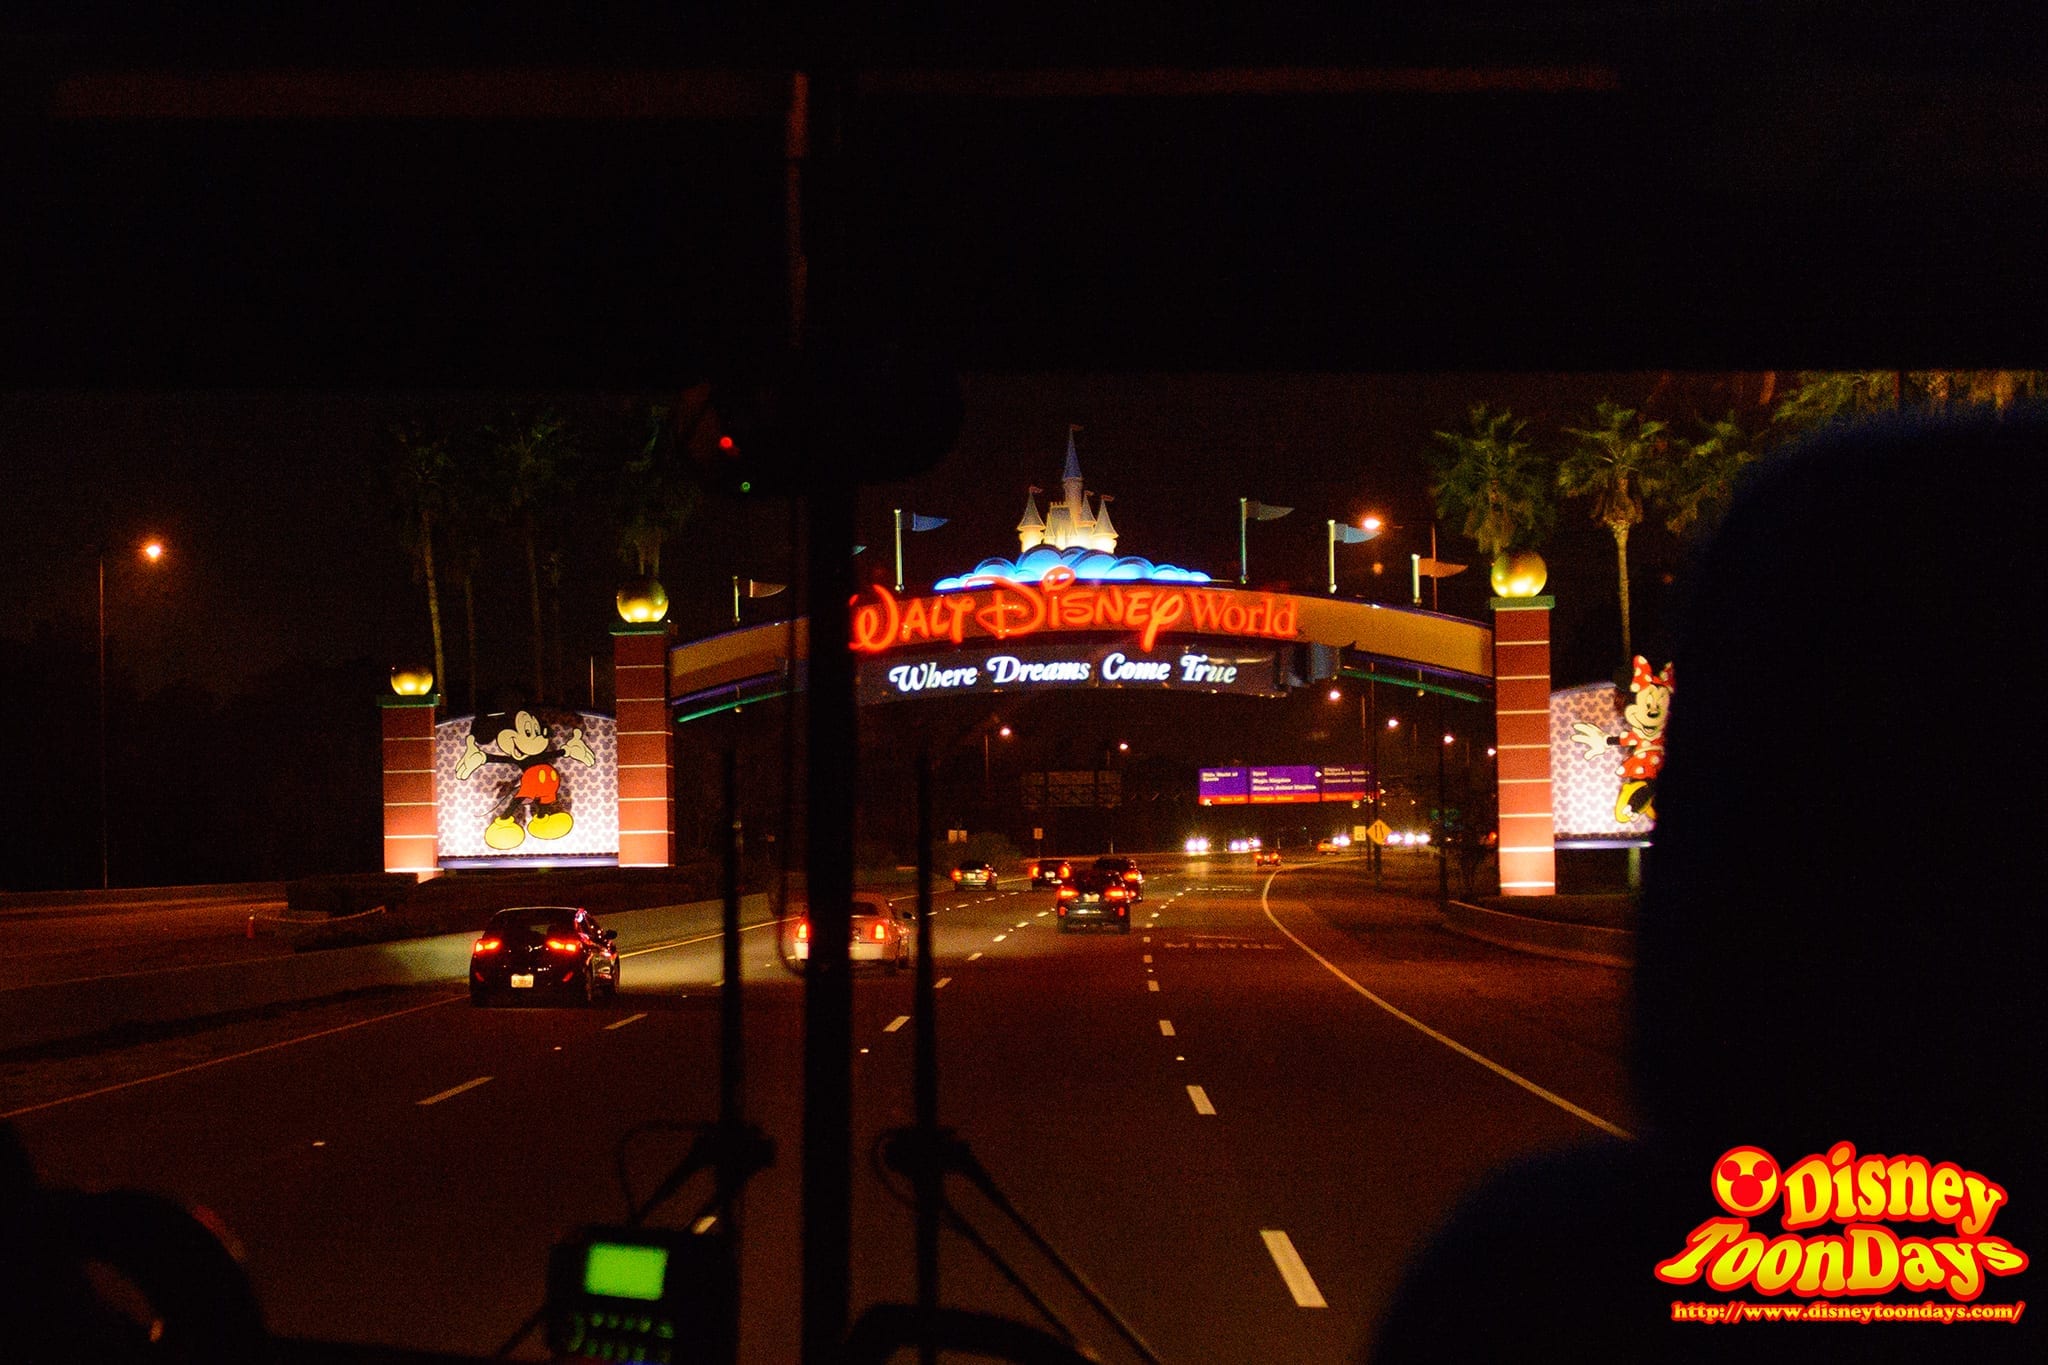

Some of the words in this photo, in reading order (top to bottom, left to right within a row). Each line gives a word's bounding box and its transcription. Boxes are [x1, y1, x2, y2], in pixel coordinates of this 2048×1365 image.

[1186, 590, 1298, 638] World
[889, 662, 978, 692] Where
[986, 655, 1091, 683] Dreams
[1102, 653, 1172, 681] Come
[1180, 654, 1238, 684] True
